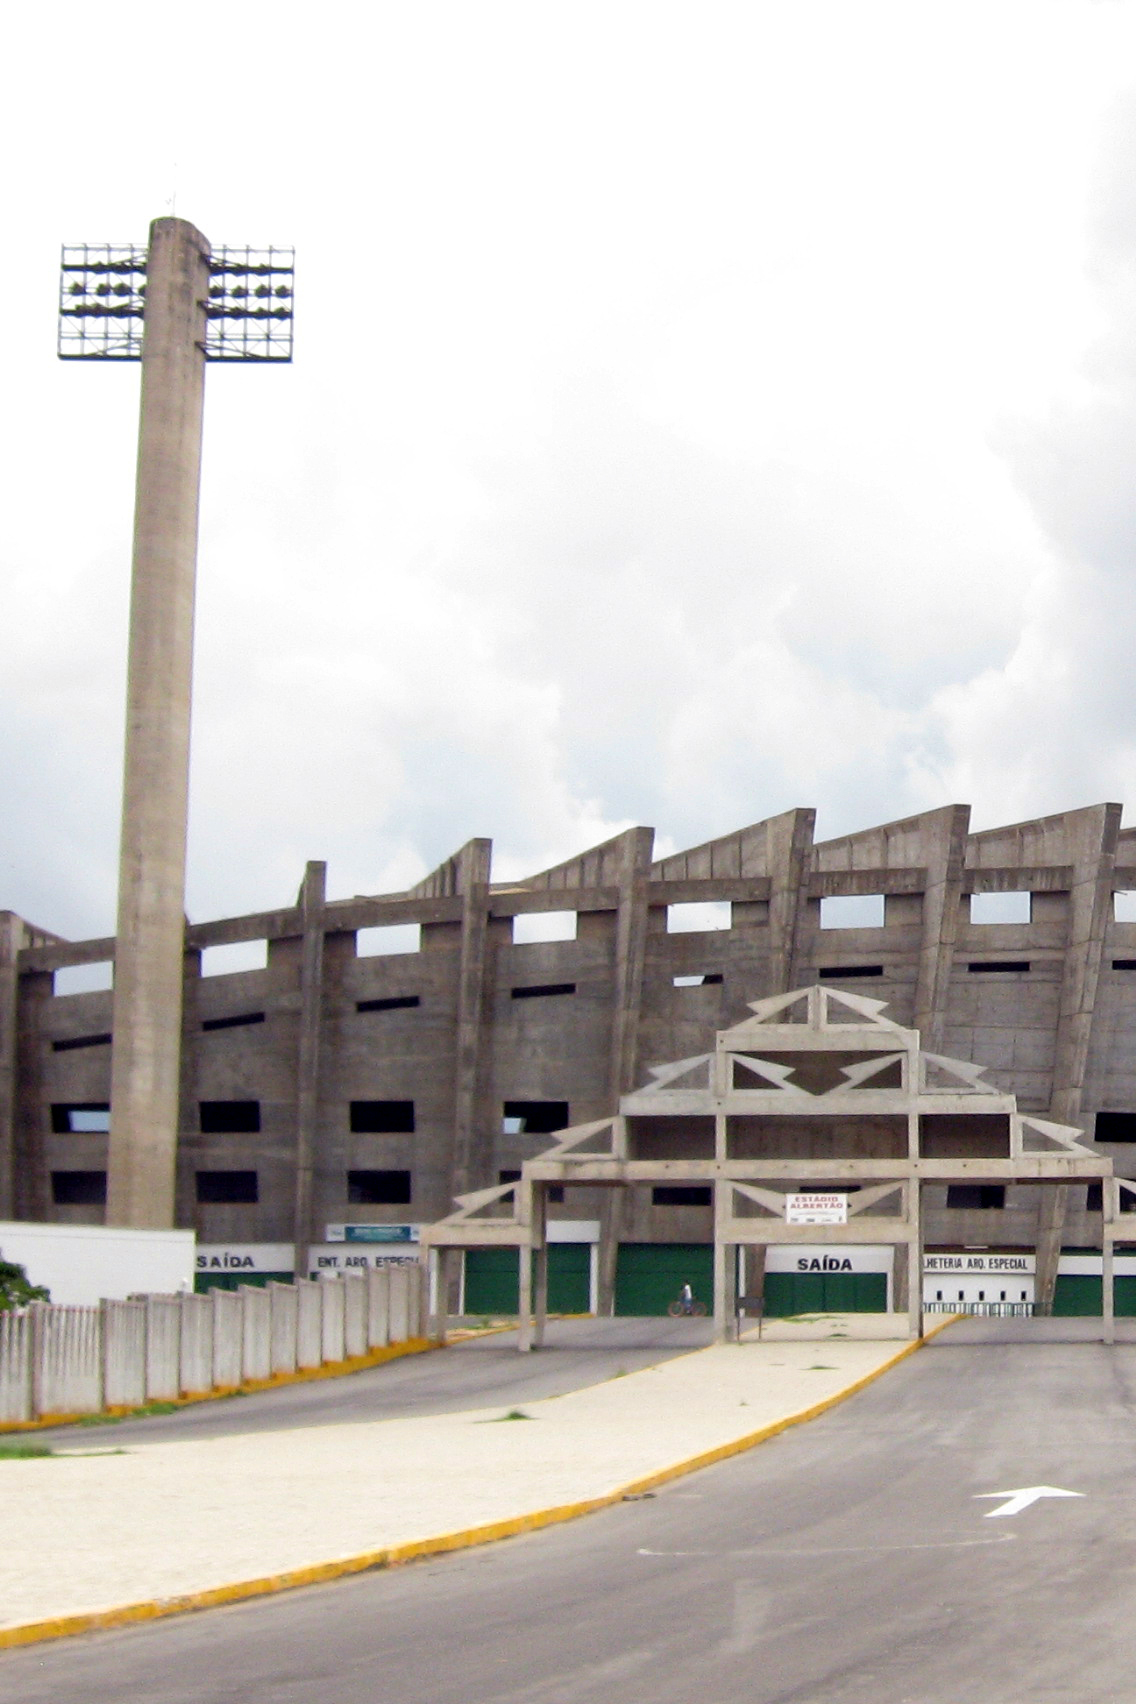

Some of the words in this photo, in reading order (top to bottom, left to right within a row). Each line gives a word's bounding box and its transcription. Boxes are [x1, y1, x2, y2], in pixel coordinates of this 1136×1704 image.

[196, 1252, 255, 1268] SAÍDA
[797, 1254, 853, 1271] SAÍDA
[988, 1258, 1028, 1270] ESPECIAL
